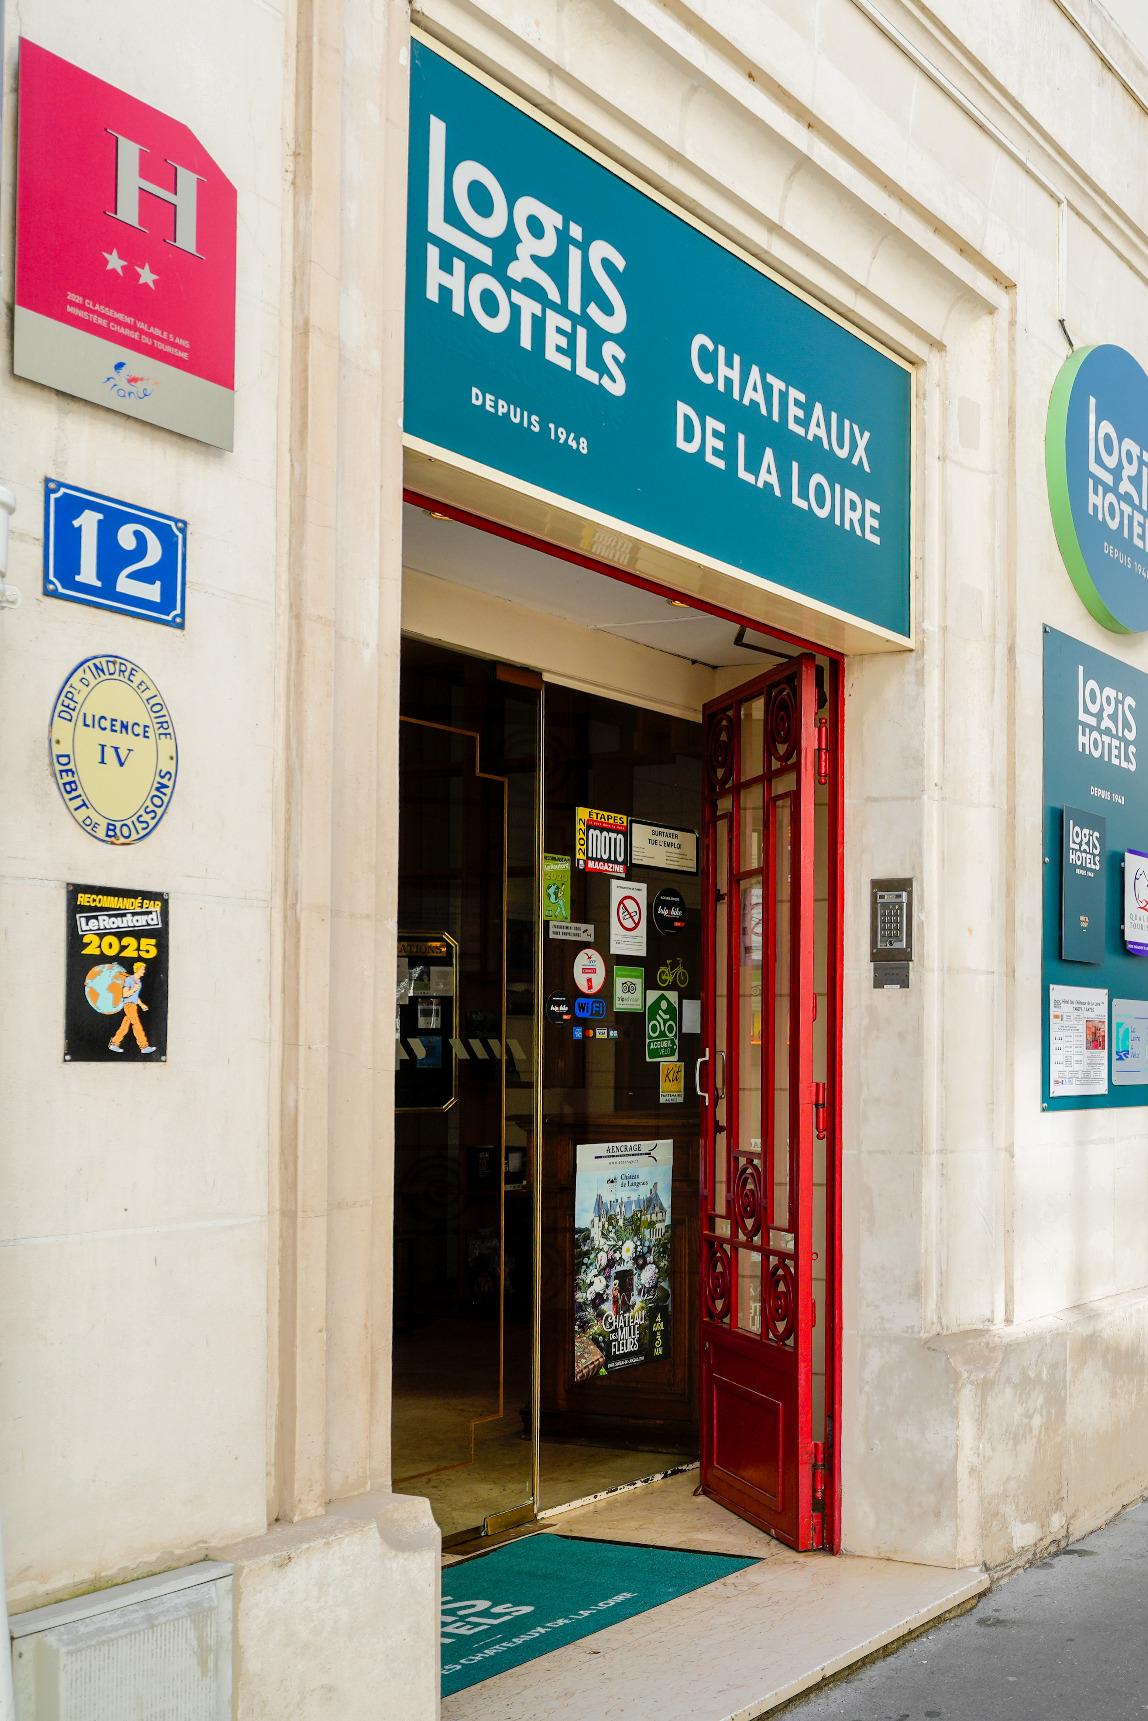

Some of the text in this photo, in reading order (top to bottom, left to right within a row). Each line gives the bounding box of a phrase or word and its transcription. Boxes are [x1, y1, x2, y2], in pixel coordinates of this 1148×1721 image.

[103, 128, 207, 260] H
[84, 299, 136, 326] CLASSEMENT
[135, 319, 169, 340] VALABLE
[168, 333, 175, 342] 5
[174, 335, 191, 349] ANS
[426, 242, 628, 397] HOTELS
[141, 335, 153, 346] DU
[153, 339, 190, 361] TOURISME
[690, 333, 872, 473] CHATEAUX
[470, 386, 589, 456] DEPUIS 1948
[676, 400, 882, 546] DE LA LOIRE
[71, 508, 163, 603] 12
[1103, 541, 1133, 569] DEPUIS
[136, 679, 151, 694] ET
[147, 693, 173, 742] LOIRE
[82, 712, 151, 740] LICENCE
[97, 743, 134, 768] IV
[1078, 724, 1137, 773] HOTELS
[55, 753, 173, 840] DÉBIT DE BOISSONS
[1090, 785, 1112, 801] DEPUIS
[588, 810, 625, 825] ÉTAPES
[577, 818, 586, 856] 2022
[588, 828, 625, 862] MOTO
[648, 838, 659, 847] TUE
[651, 829, 679, 840] SURTAXER
[588, 860, 624, 873] MAGAZINE
[1069, 852, 1100, 871] HOTELS
[77, 893, 162, 912] RECOMMANDÉ PAR
[81, 933, 158, 959] 2025
[650, 1039, 673, 1049] ACCUEIL
[606, 1144, 642, 1153] AENCRAGE
[655, 1312, 662, 1323] 4
[618, 1325, 640, 1341] MILLE
[611, 1338, 639, 1356] FLEURS
[458, 1626, 550, 1665] CHATEAUX
[547, 1617, 570, 1629] DE
[571, 1607, 596, 1620] LA
[595, 1591, 639, 1611] LOIRE
